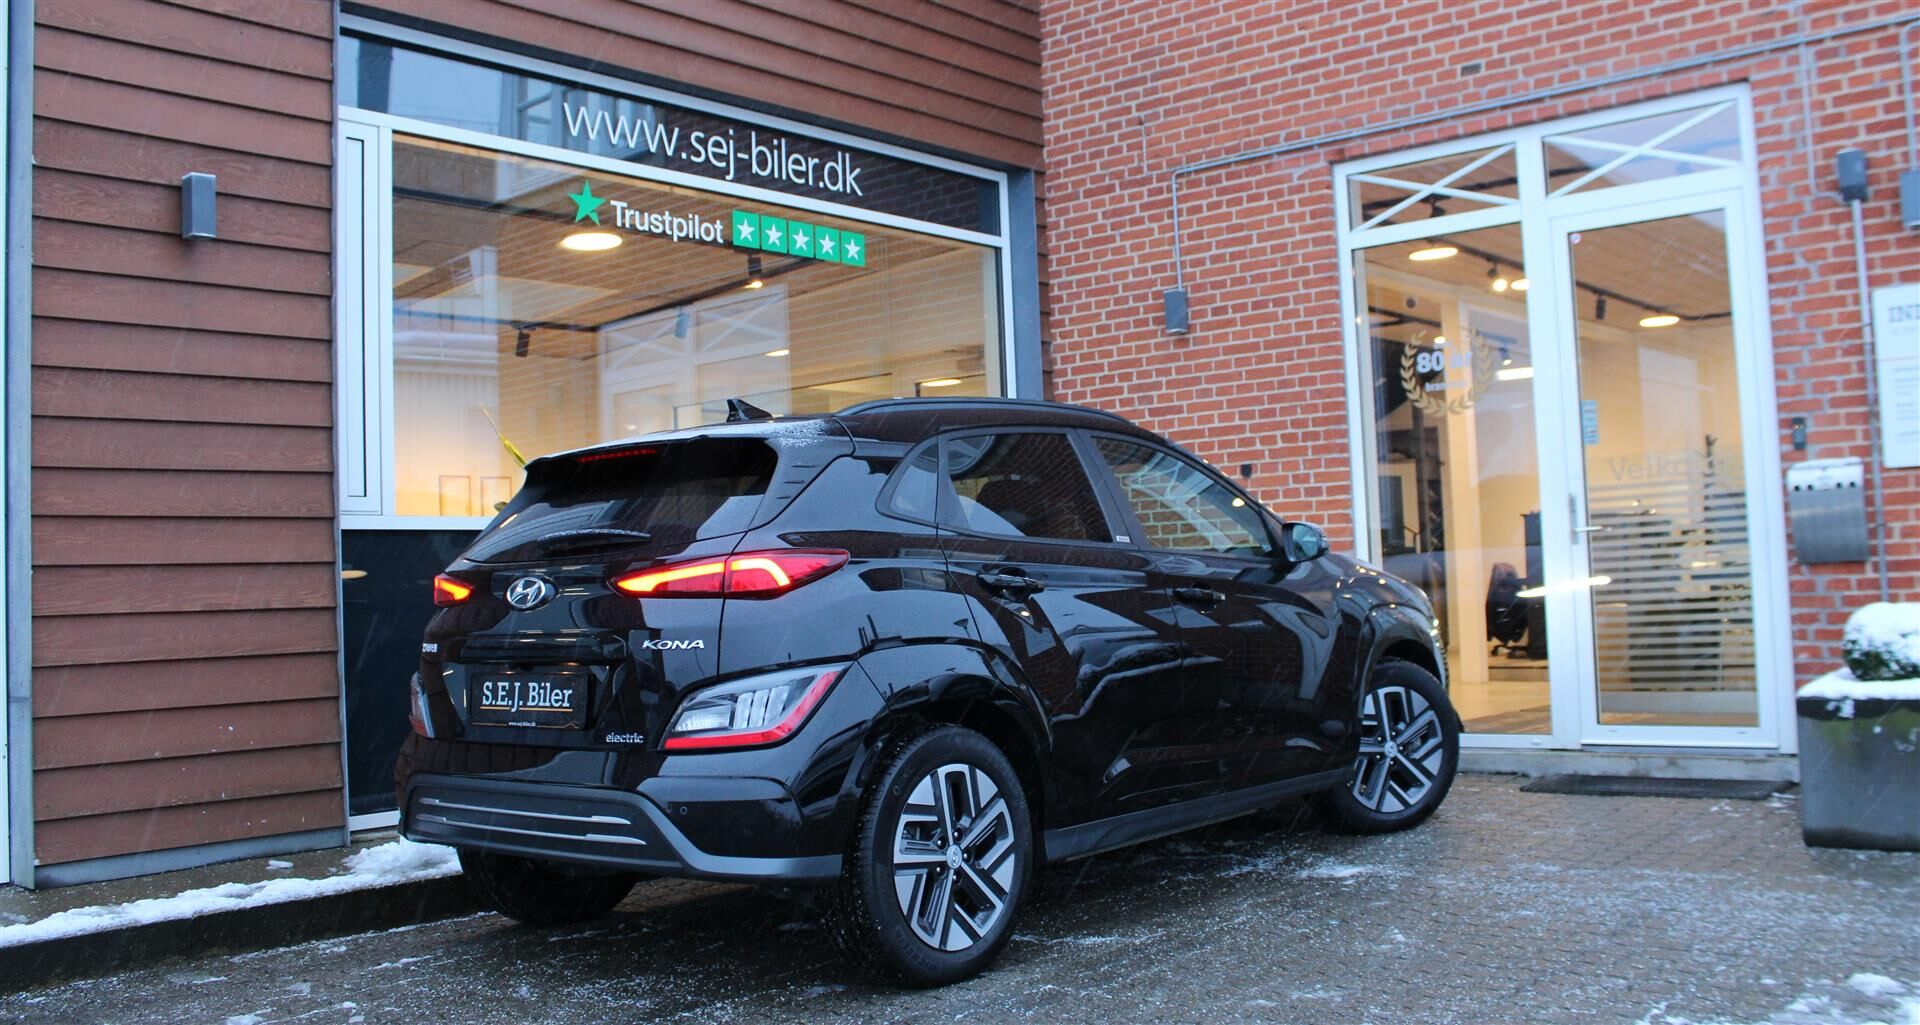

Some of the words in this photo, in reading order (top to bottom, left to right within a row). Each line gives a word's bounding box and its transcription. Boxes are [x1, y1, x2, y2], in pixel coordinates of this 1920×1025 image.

[563, 102, 863, 196] www.sej-biler.dk
[610, 200, 724, 243] Trustpilot
[1416, 351, 1445, 374] 80
[641, 639, 705, 650] KONA
[482, 681, 523, 713] S.E.J.
[526, 682, 573, 707] Biler
[606, 732, 644, 744] electric
